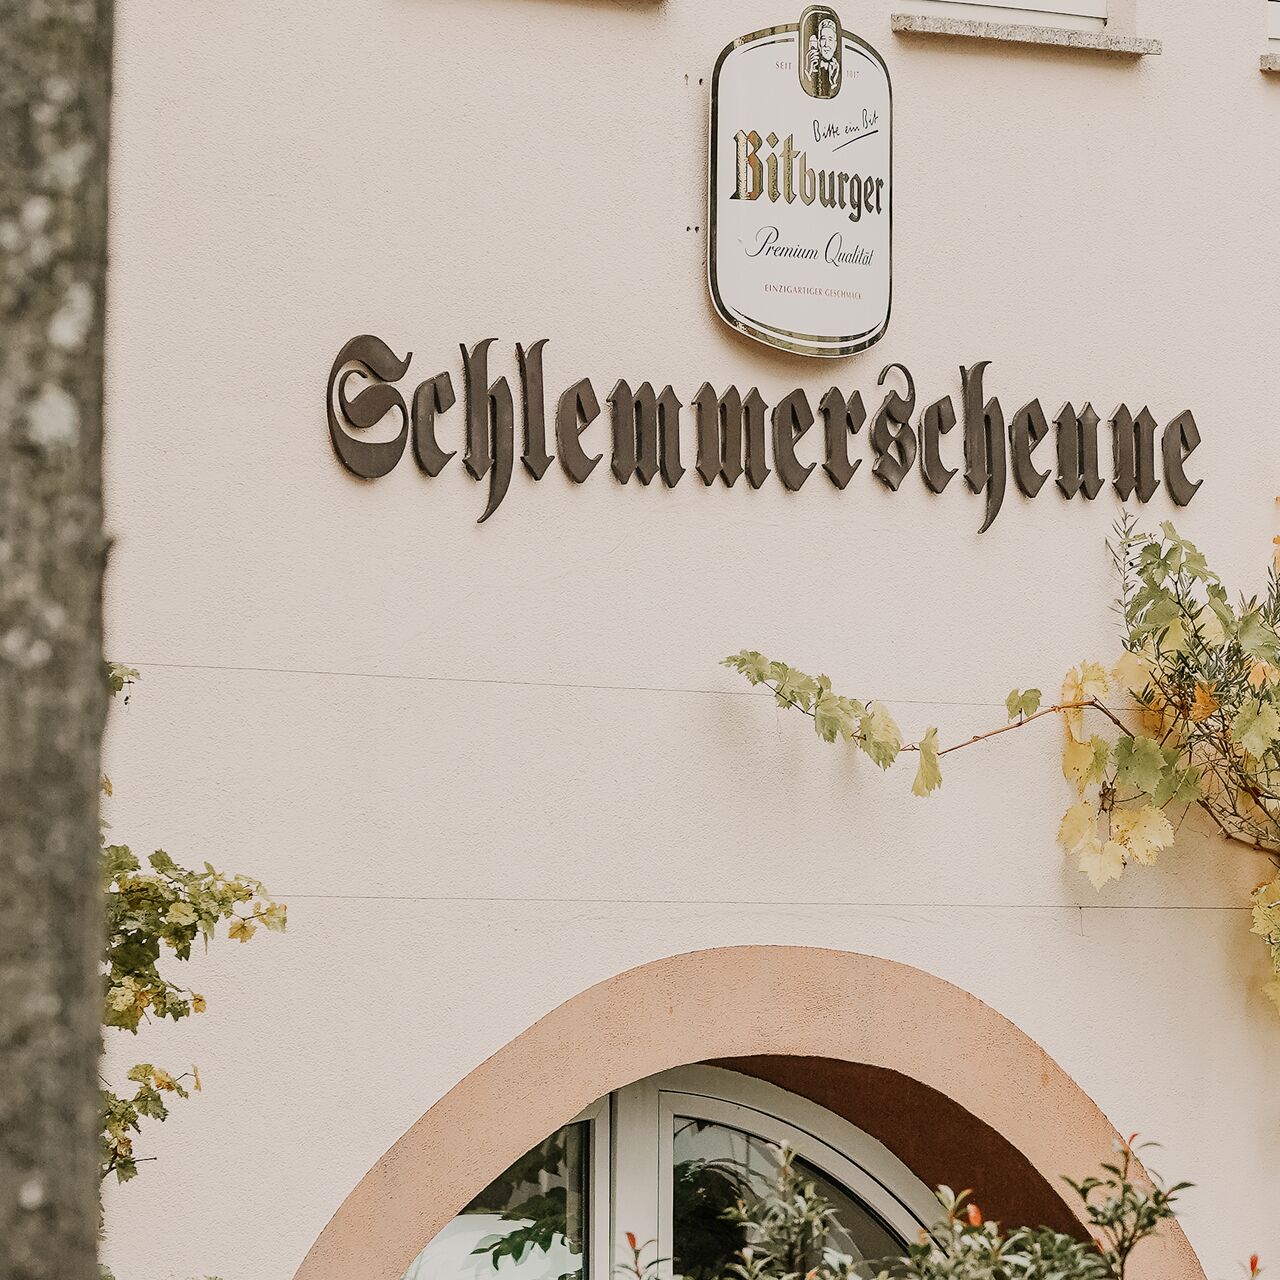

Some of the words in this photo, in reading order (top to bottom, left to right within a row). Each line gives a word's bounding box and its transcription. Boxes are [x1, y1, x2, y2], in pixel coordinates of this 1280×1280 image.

[775, 61, 792, 70] SEIT
[812, 119, 840, 143] Bitte
[844, 122, 860, 134] ein
[862, 108, 879, 130] Bit
[729, 128, 885, 223] Bitburger
[744, 225, 819, 259] Premium
[824, 231, 874, 267] Qualität
[764, 283, 823, 296] EINZIGARTIGER
[824, 288, 863, 300] GESCHMACK
[326, 332, 1205, 534] Schlemmerscheune
